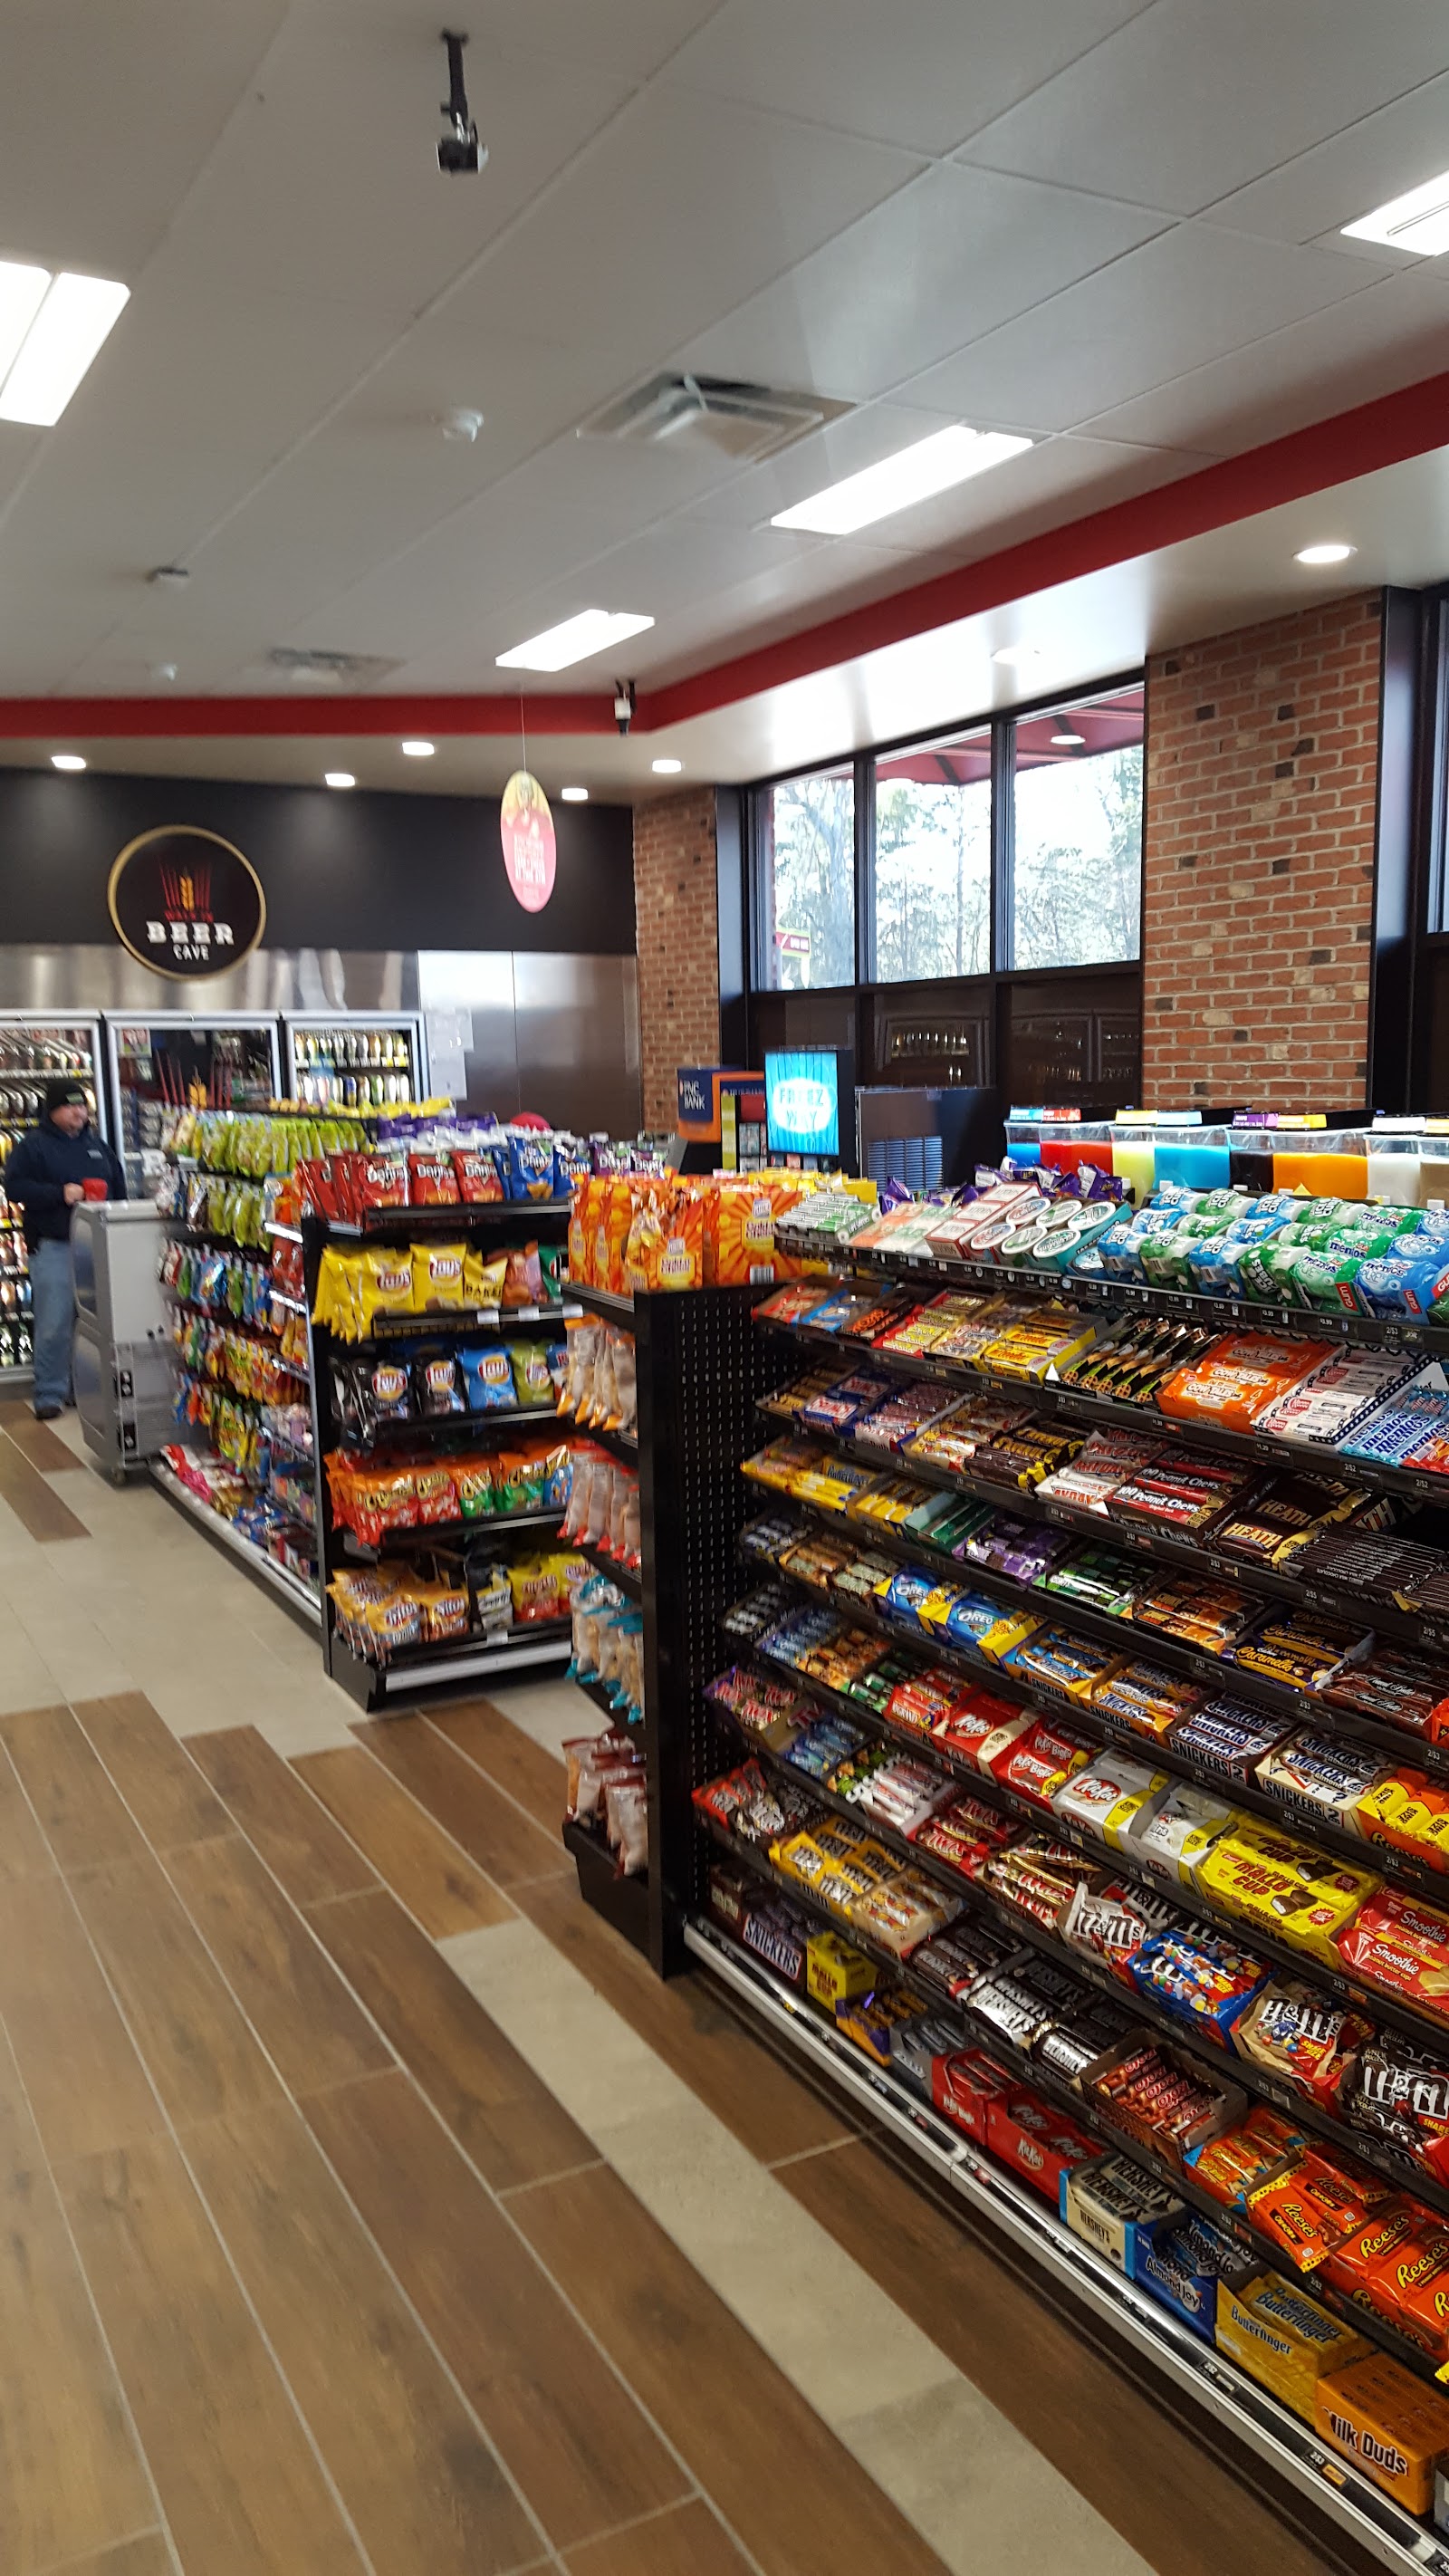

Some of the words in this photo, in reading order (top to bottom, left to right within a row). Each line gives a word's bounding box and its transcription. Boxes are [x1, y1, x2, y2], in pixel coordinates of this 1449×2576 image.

[146, 921, 235, 945] BEER
[173, 944, 209, 960] CAVE
[684, 1080, 700, 1095] PNC
[684, 1094, 705, 1110] BANK
[1329, 1241, 1367, 1259] mentos
[1339, 1284, 1353, 1308] GUM
[1406, 1291, 1417, 1311] GUM
[1387, 1327, 1399, 1335] 2/$3
[1214, 1368, 1237, 1379] COW
[1234, 1371, 1261, 1385] TALES
[1187, 1383, 1210, 1394] COW
[1208, 1386, 1234, 1399] TALES
[1250, 1389, 1263, 1403] 4
[1411, 1396, 1425, 1412] mint
[1361, 1412, 1408, 1451] mentos
[1375, 1414, 1422, 1454] mentos
[1398, 1421, 1446, 1460] mentos
[1156, 1471, 1188, 1486] Peanut
[1188, 1476, 1222, 1490] Chews
[1134, 1491, 1167, 1507] Peanut
[1166, 1498, 1201, 1514] Chews
[1255, 1499, 1312, 1528] HEATH
[1222, 1522, 1283, 1550] HEATH
[957, 1607, 994, 1625] OREO
[1236, 1646, 1296, 1672] Caramello
[1031, 1677, 1065, 1699] SNICKERS
[1089, 1706, 1131, 1732] SNICKERS
[1172, 1739, 1229, 1776] SNICKERS
[1427, 1749, 1440, 1761] 2/$3
[1232, 1765, 1243, 1776] 2
[1287, 1752, 1347, 1786] SNICKERS
[1313, 1772, 1343, 1791] Almond
[1265, 1779, 1323, 1817] SNICKERS
[1328, 1808, 1340, 1820] 2
[1396, 1805, 1413, 1820] SIZE
[1403, 1806, 1419, 1824] KING
[1426, 1817, 1444, 1831] SIZE
[1431, 1819, 1449, 1836] KING
[1233, 1861, 1290, 1891] MALLO
[1233, 1876, 1270, 1895] CUP
[1400, 1910, 1447, 1943] Smoothie
[745, 1918, 800, 1976] SNICKERS
[1372, 1943, 1420, 1975] Smoothie
[1384, 1962, 1401, 1975] butter
[1400, 1971, 1413, 1982] cups
[1080, 2208, 1111, 2244] HERSHEY'S
[1281, 2203, 1319, 2239] Reese's
[1360, 2216, 1410, 2259] Reese's
[1396, 2241, 1449, 2289] Reese's
[1146, 2254, 1182, 2292] Almond
[1182, 2283, 1200, 2309] Joy
[1255, 2291, 1332, 2343] Butterfinger
[1232, 2304, 1293, 2355] Butterfinger
[1321, 2406, 1358, 2449] Milk
[1361, 2430, 1408, 2476] Duds
